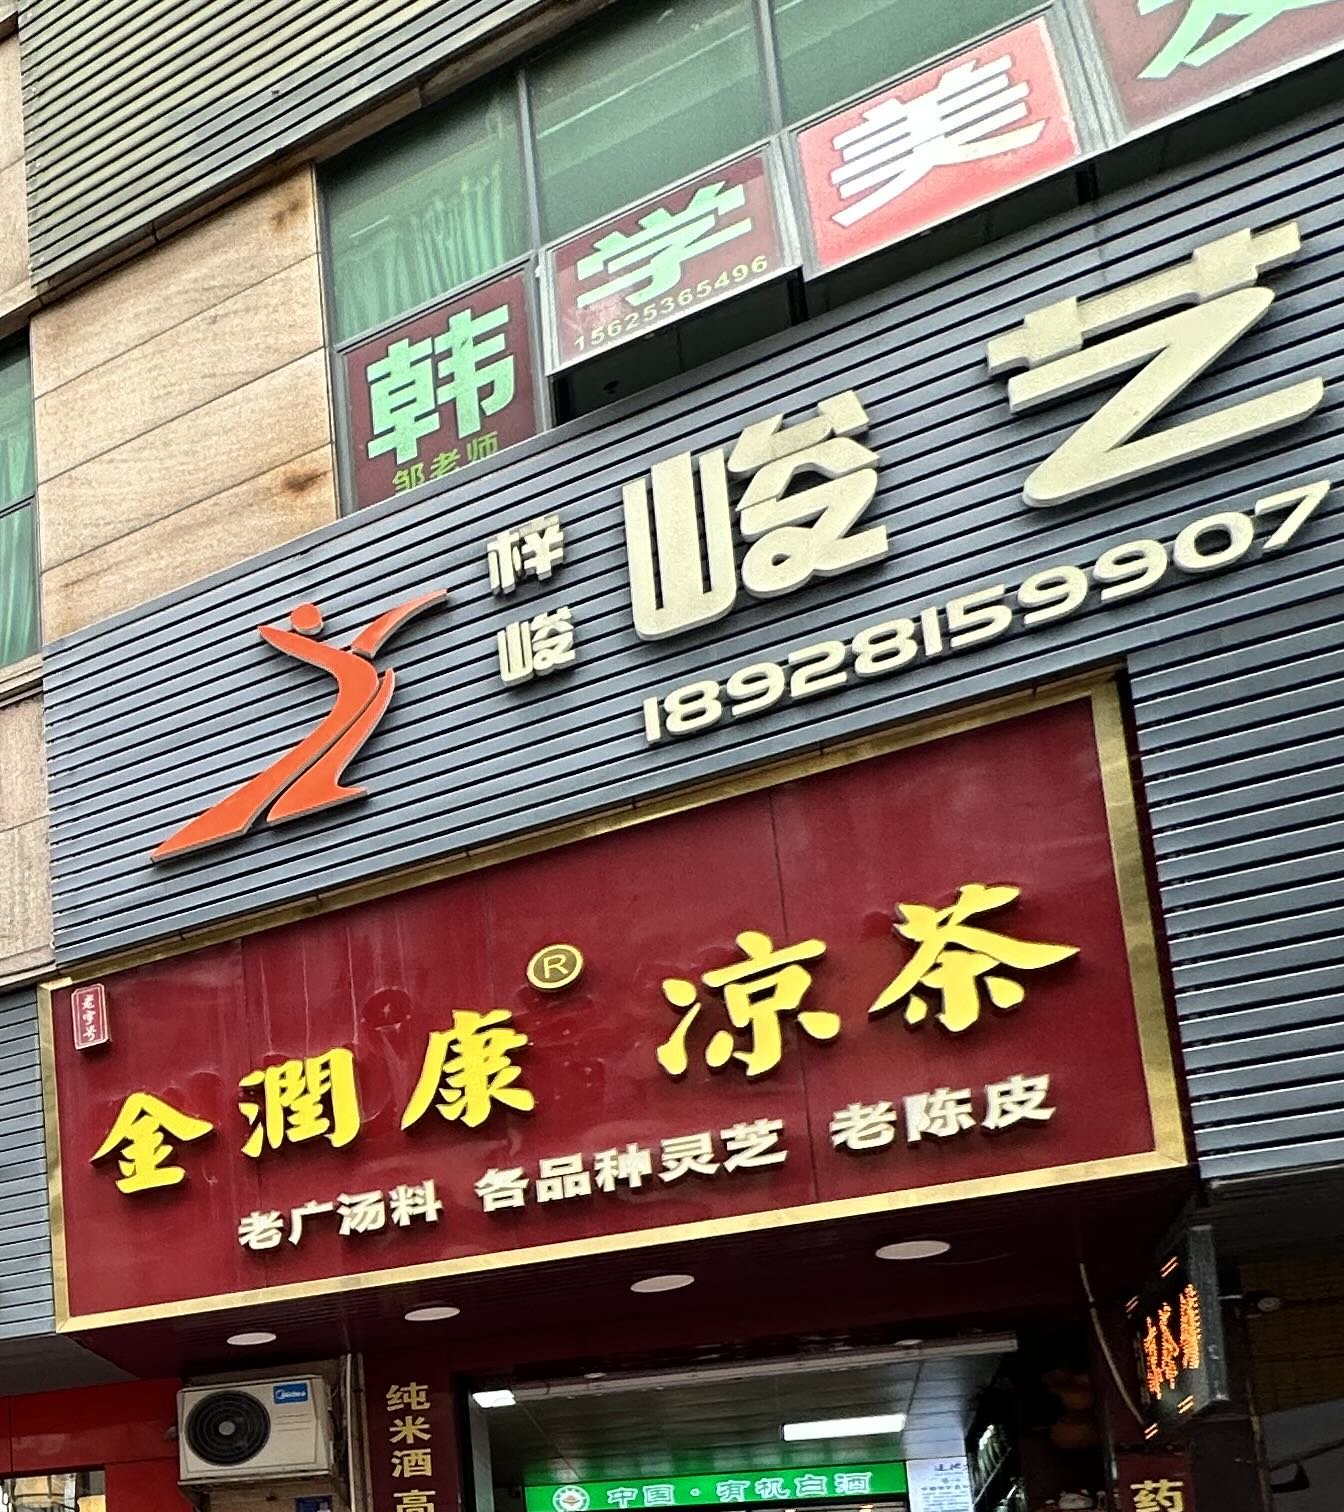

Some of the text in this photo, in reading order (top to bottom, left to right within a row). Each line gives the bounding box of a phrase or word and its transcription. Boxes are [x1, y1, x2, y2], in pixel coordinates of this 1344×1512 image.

[572, 255, 769, 353] 15625365496
[645, 480, 1332, 745] 18928159907
[237, 1073, 1058, 1254] 老广汤料 各品种灵芝 老陈皮
[386, 1381, 433, 1479] 纯米酒
